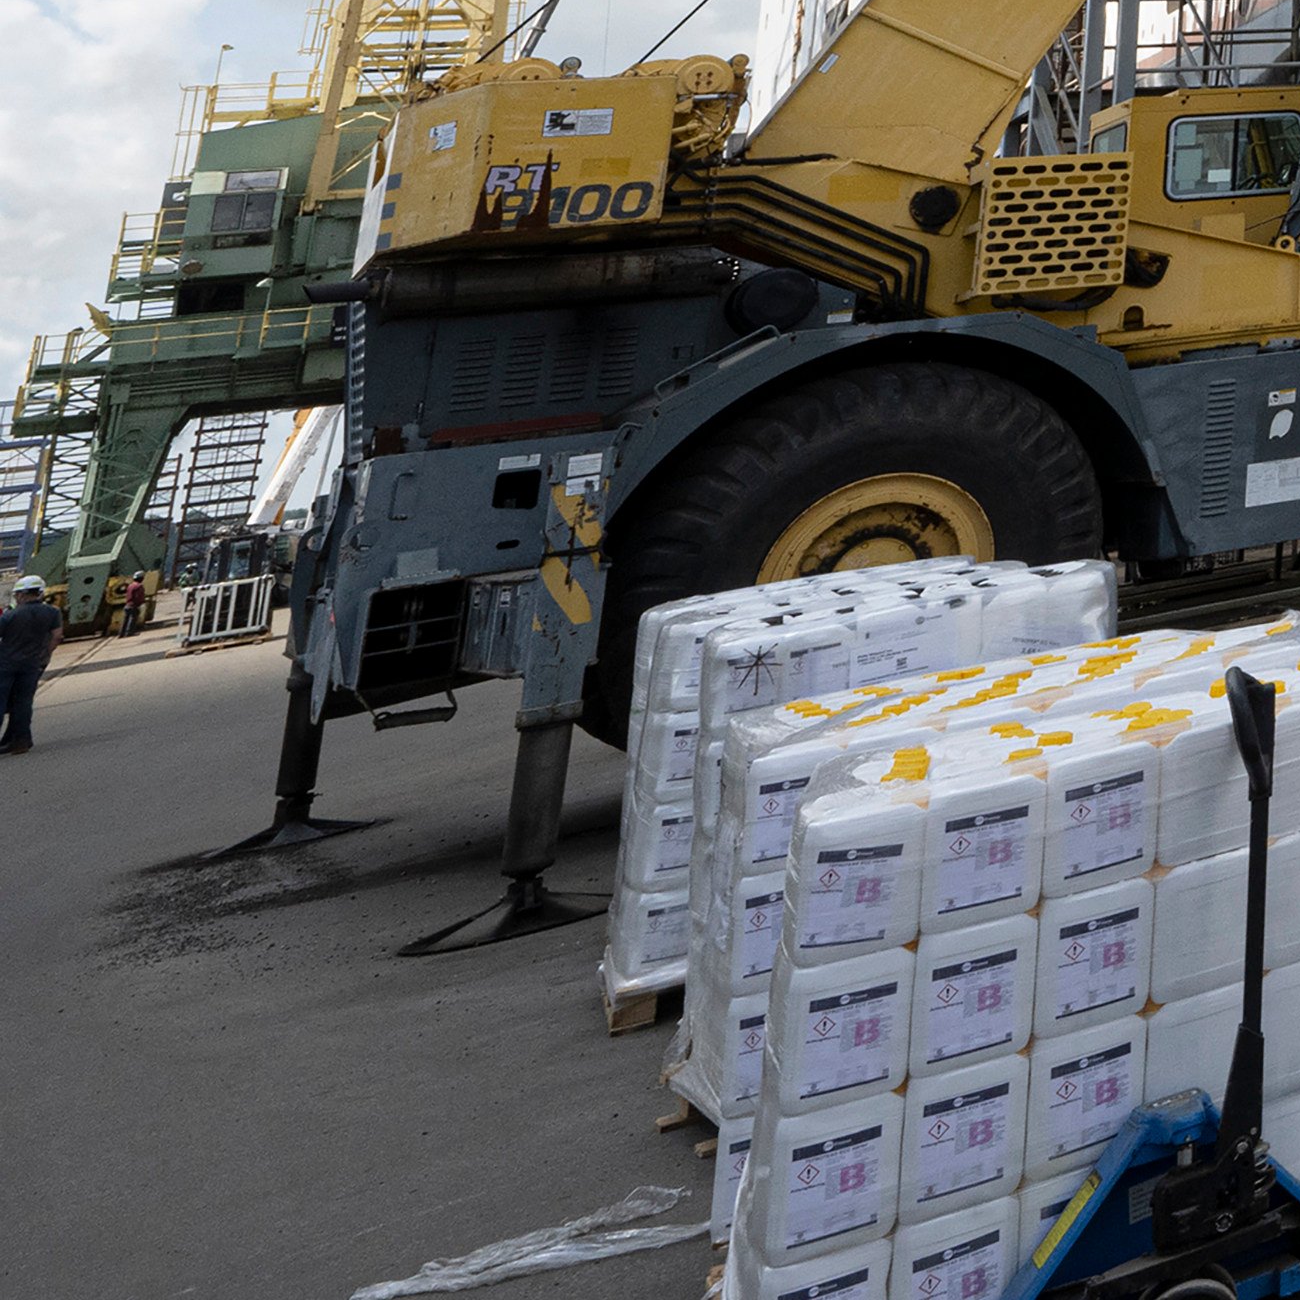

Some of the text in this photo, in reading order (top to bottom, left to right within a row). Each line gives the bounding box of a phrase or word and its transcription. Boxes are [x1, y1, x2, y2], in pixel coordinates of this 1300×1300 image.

[485, 162, 560, 195] RT
[500, 181, 654, 228] 9100
[1109, 804, 1131, 829] B
[988, 839, 1013, 865] B
[854, 877, 882, 903] B
[1103, 941, 1126, 968] B
[977, 984, 1001, 1012] B
[854, 1018, 882, 1047] B
[1095, 1077, 1119, 1105] B
[968, 1118, 993, 1148] B
[839, 1163, 865, 1193] B
[962, 1268, 987, 1299] B
